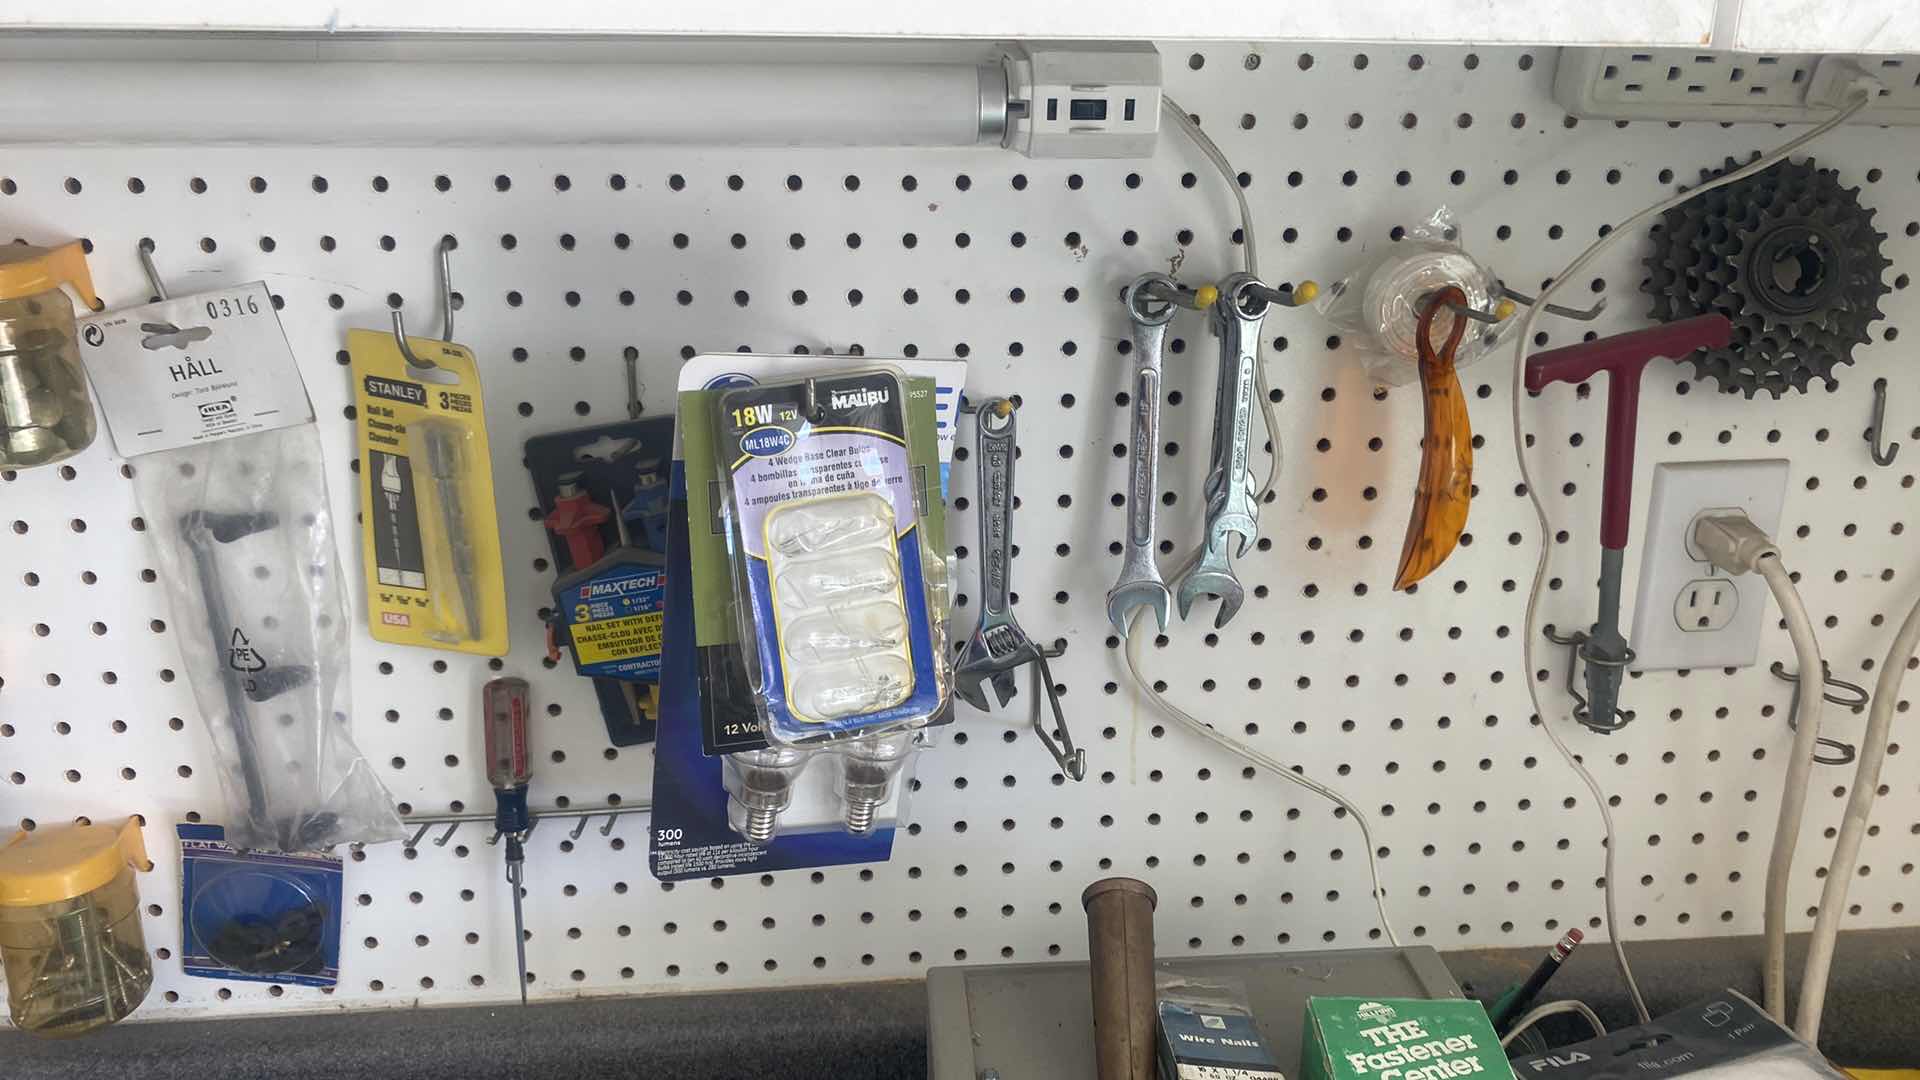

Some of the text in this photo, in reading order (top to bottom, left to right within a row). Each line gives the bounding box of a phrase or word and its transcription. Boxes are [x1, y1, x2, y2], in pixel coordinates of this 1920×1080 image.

[206, 295, 258, 319] 0316
[169, 356, 222, 382] HÅLL
[368, 381, 422, 400] STANLEY
[439, 392, 450, 410] 3
[731, 404, 798, 427] 18W 12V
[768, 458, 773, 466] 4
[826, 448, 846, 459] Clear
[751, 474, 756, 482] 4
[758, 468, 797, 482] bombillas
[788, 479, 798, 488] en
[825, 474, 834, 482] de
[836, 470, 855, 481] cuña
[744, 498, 750, 506] 4
[752, 494, 790, 505] ampoules
[792, 484, 845, 500] transparentes
[592, 576, 656, 595] MAXTECH
[383, 613, 409, 625] USA
[575, 604, 590, 622] 3
[585, 623, 605, 632] NAIL
[623, 617, 643, 625] WITH
[577, 630, 631, 643] CHASSE-CLOU
[633, 627, 653, 635] AVEC
[611, 648, 628, 656] CON
[724, 724, 739, 735] 12
[658, 829, 682, 840] 300
[1179, 1034, 1260, 1048] Wire Nails
[1360, 1020, 1428, 1048] THE
[1346, 1032, 1479, 1074] Fastener
[1529, 1051, 1591, 1072] FILA
[1380, 1055, 1484, 1080] Center
